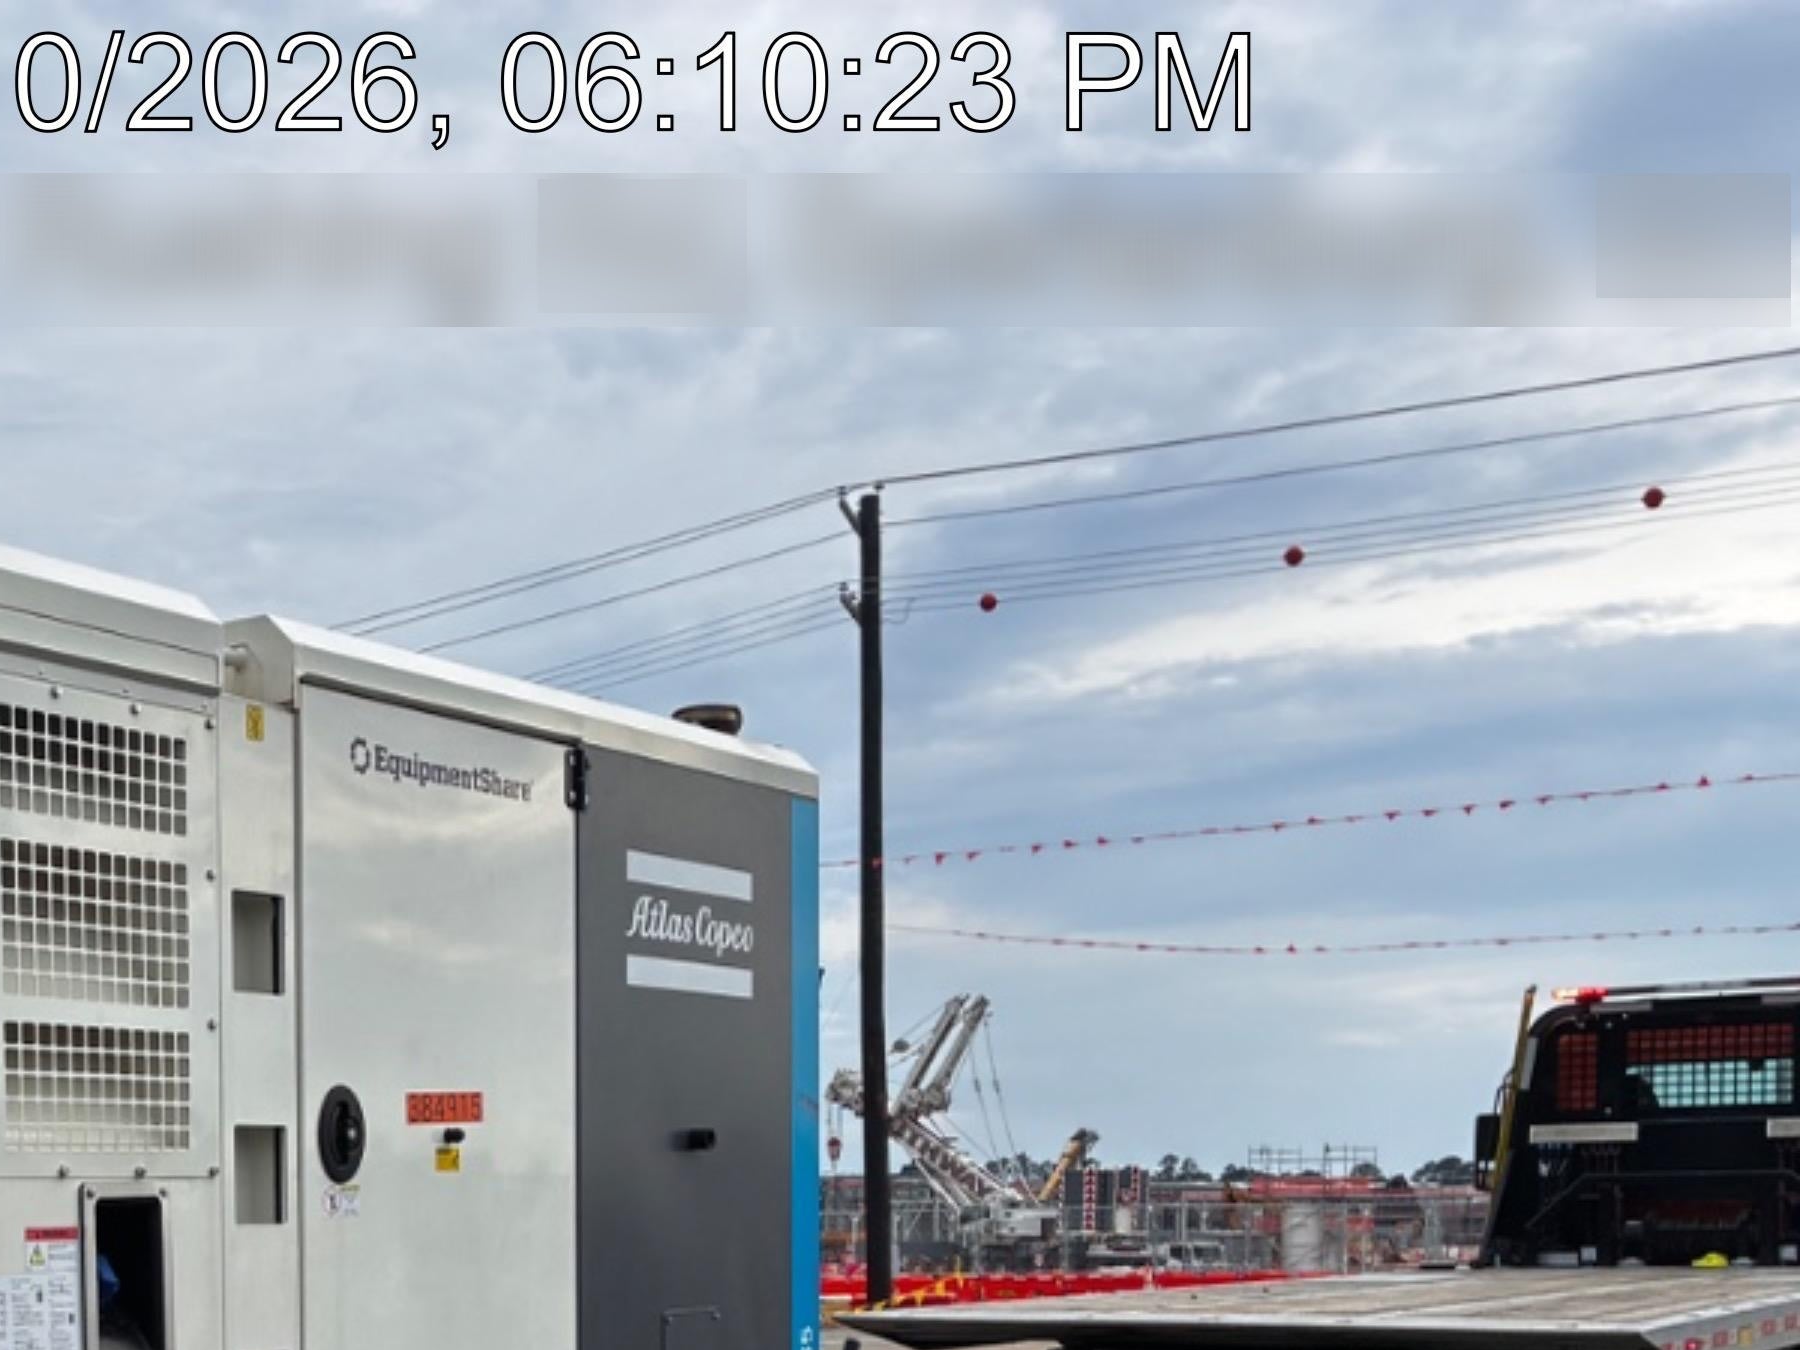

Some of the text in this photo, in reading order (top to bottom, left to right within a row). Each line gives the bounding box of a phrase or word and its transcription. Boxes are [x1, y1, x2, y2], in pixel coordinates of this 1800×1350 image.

[374, 747, 534, 801] EquipmentShare
[626, 895, 753, 957] Atlas Copco
